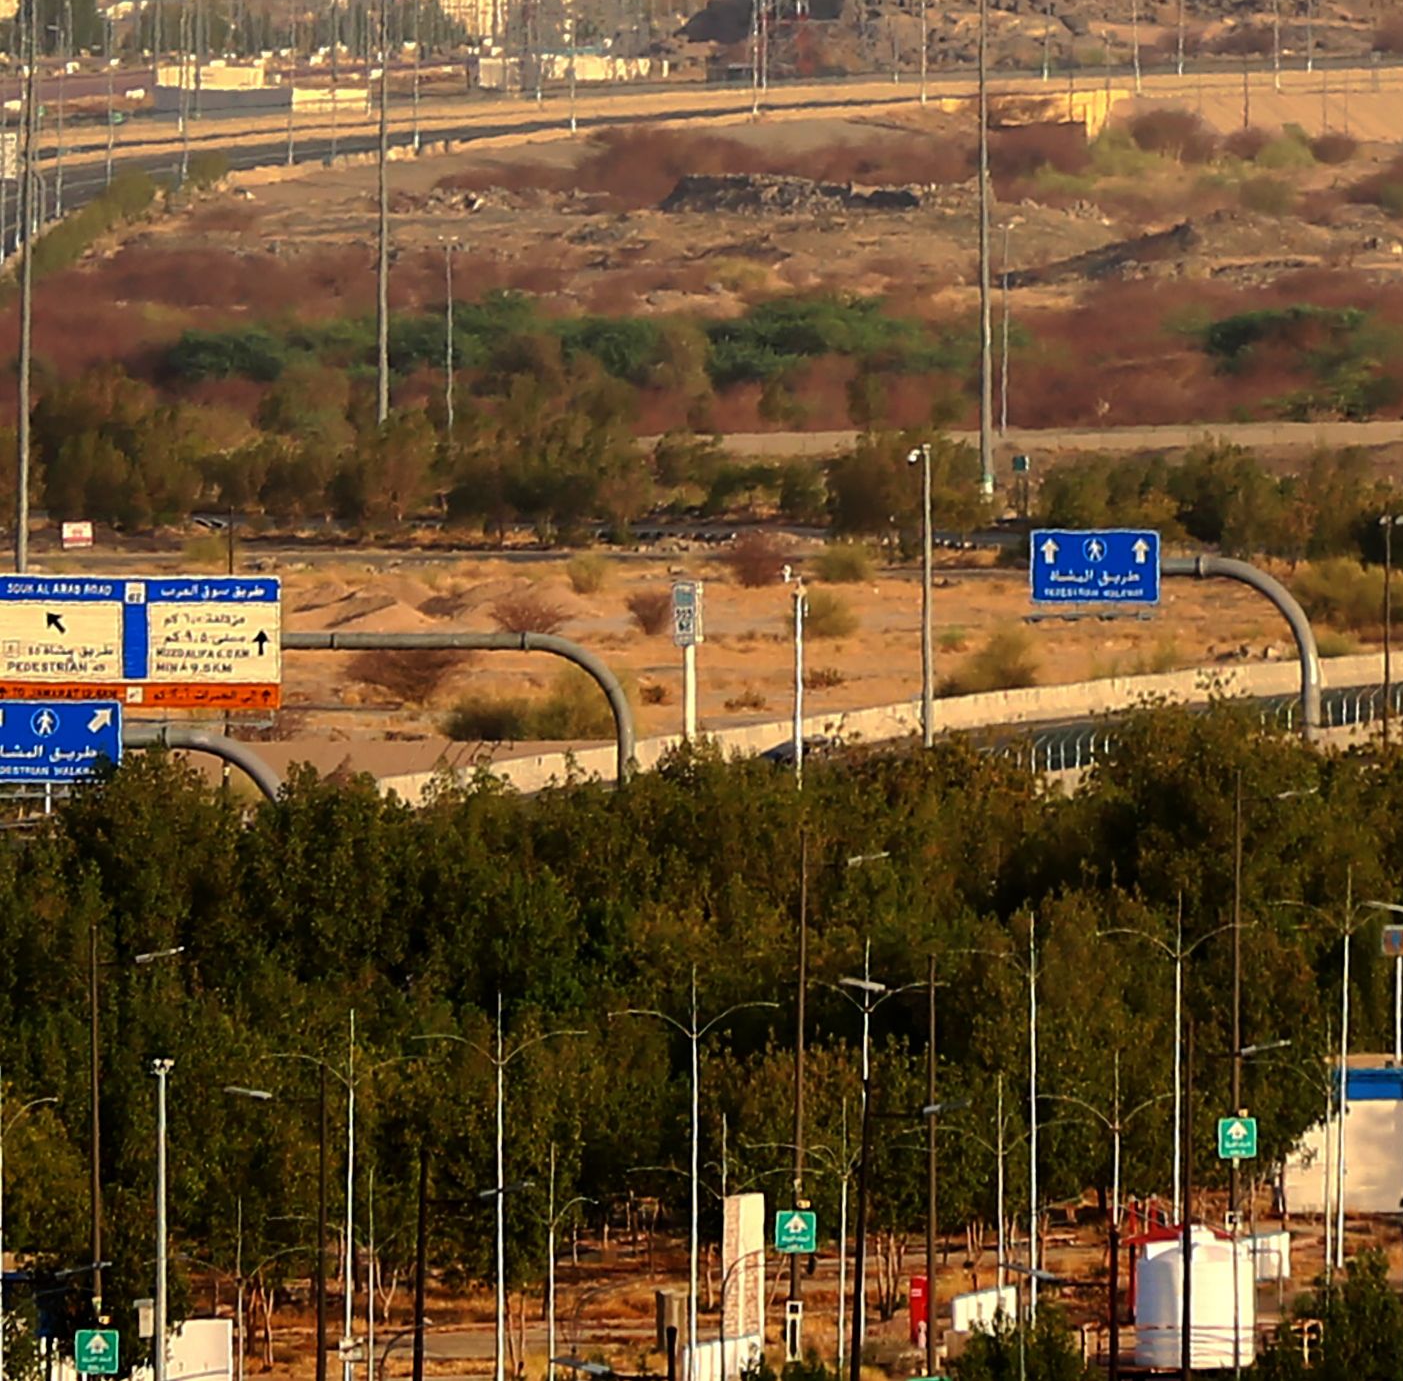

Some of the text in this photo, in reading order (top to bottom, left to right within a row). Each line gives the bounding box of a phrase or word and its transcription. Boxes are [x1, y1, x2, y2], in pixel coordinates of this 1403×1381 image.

[1049, 569, 1140, 587] طريق المشاة
[36, 583, 49, 595] AL
[52, 583, 80, 595] ARAB
[161, 584, 265, 599] طريق سوق العرب
[7, 661, 88, 673] PEDESTRIAN
[0, 744, 98, 763] طريق المشا
